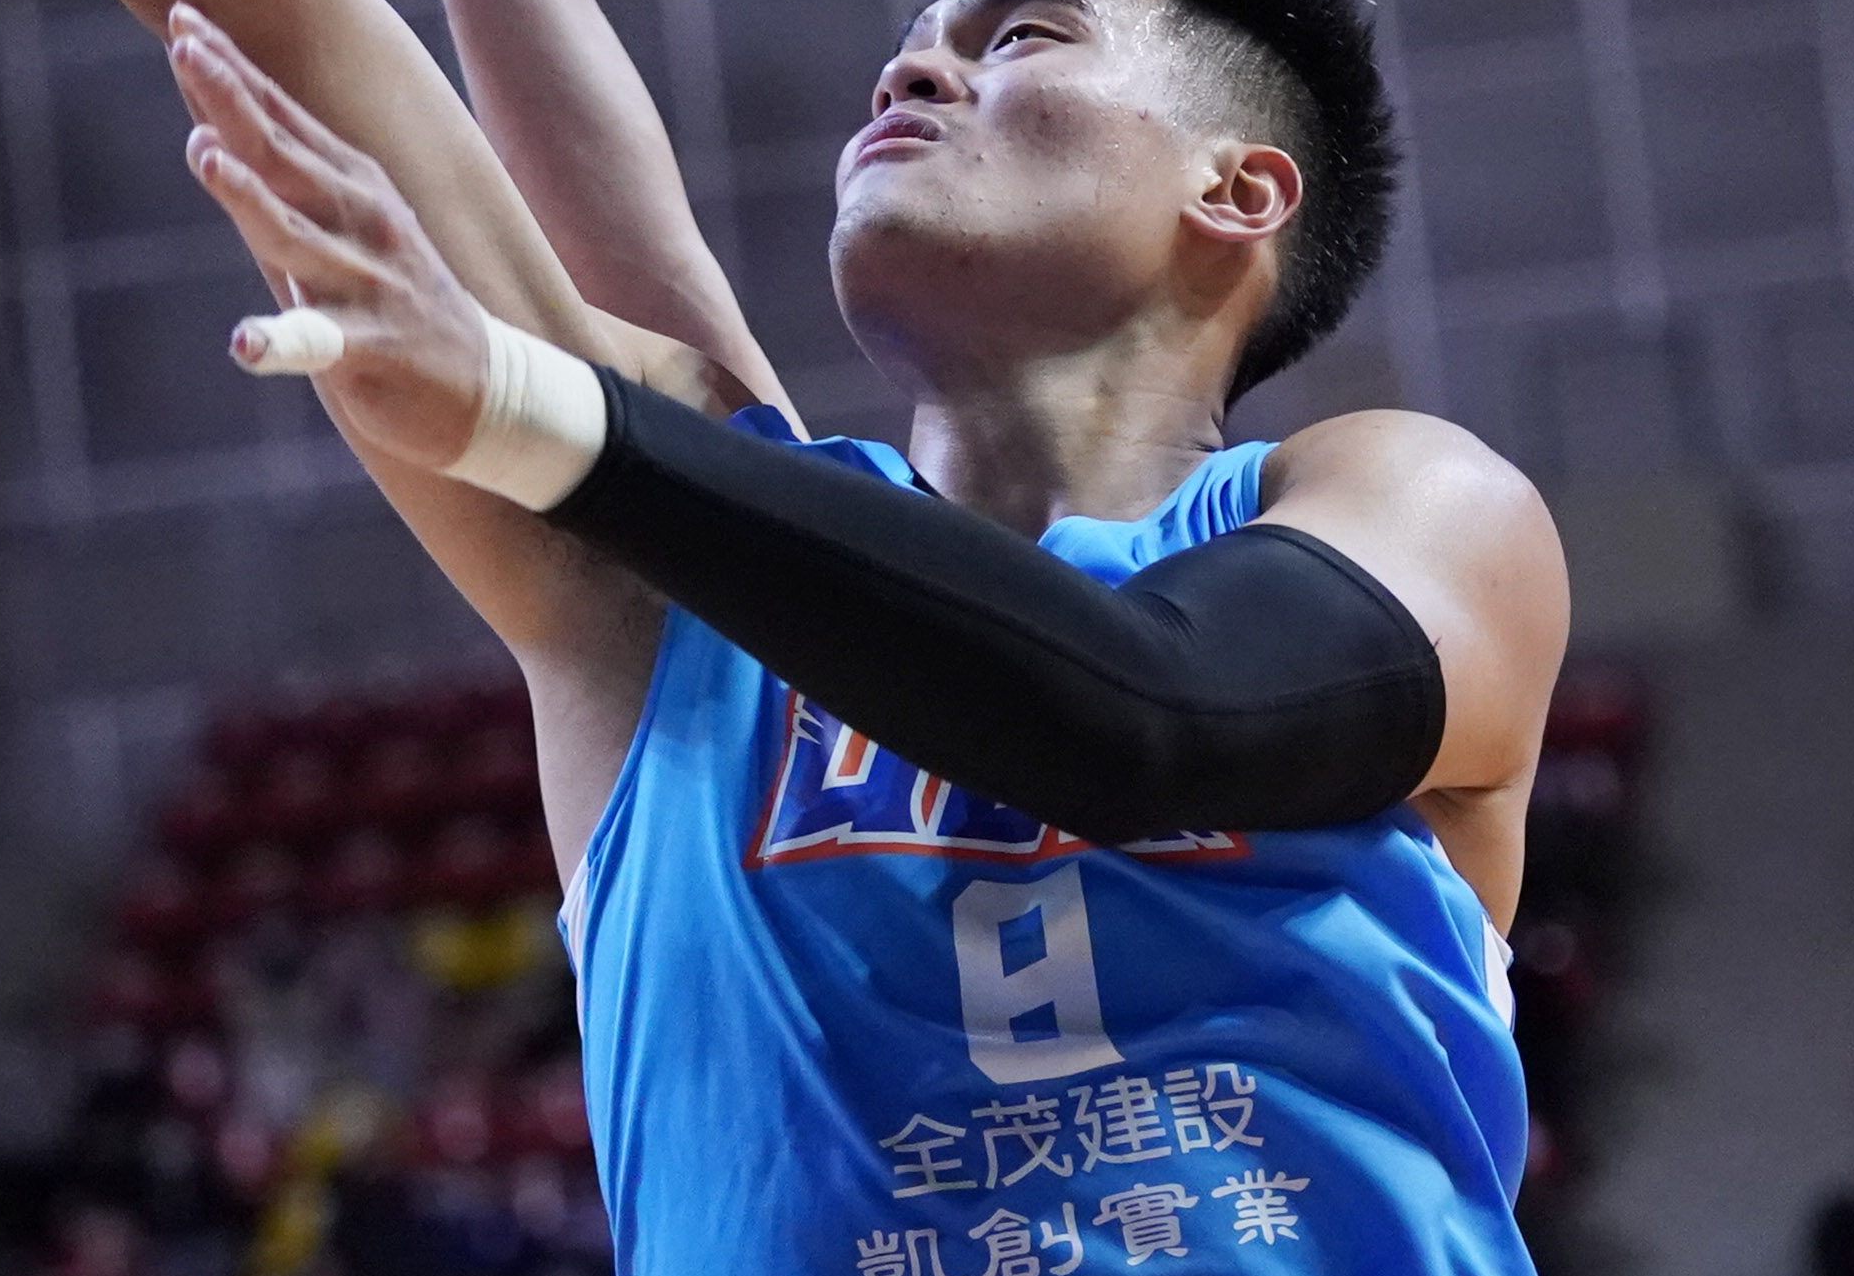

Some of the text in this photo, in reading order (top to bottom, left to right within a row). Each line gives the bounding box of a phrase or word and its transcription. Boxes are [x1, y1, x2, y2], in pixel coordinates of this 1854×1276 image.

[952, 859, 1126, 1086] 8
[877, 1061, 1266, 1201] 全茂建設
